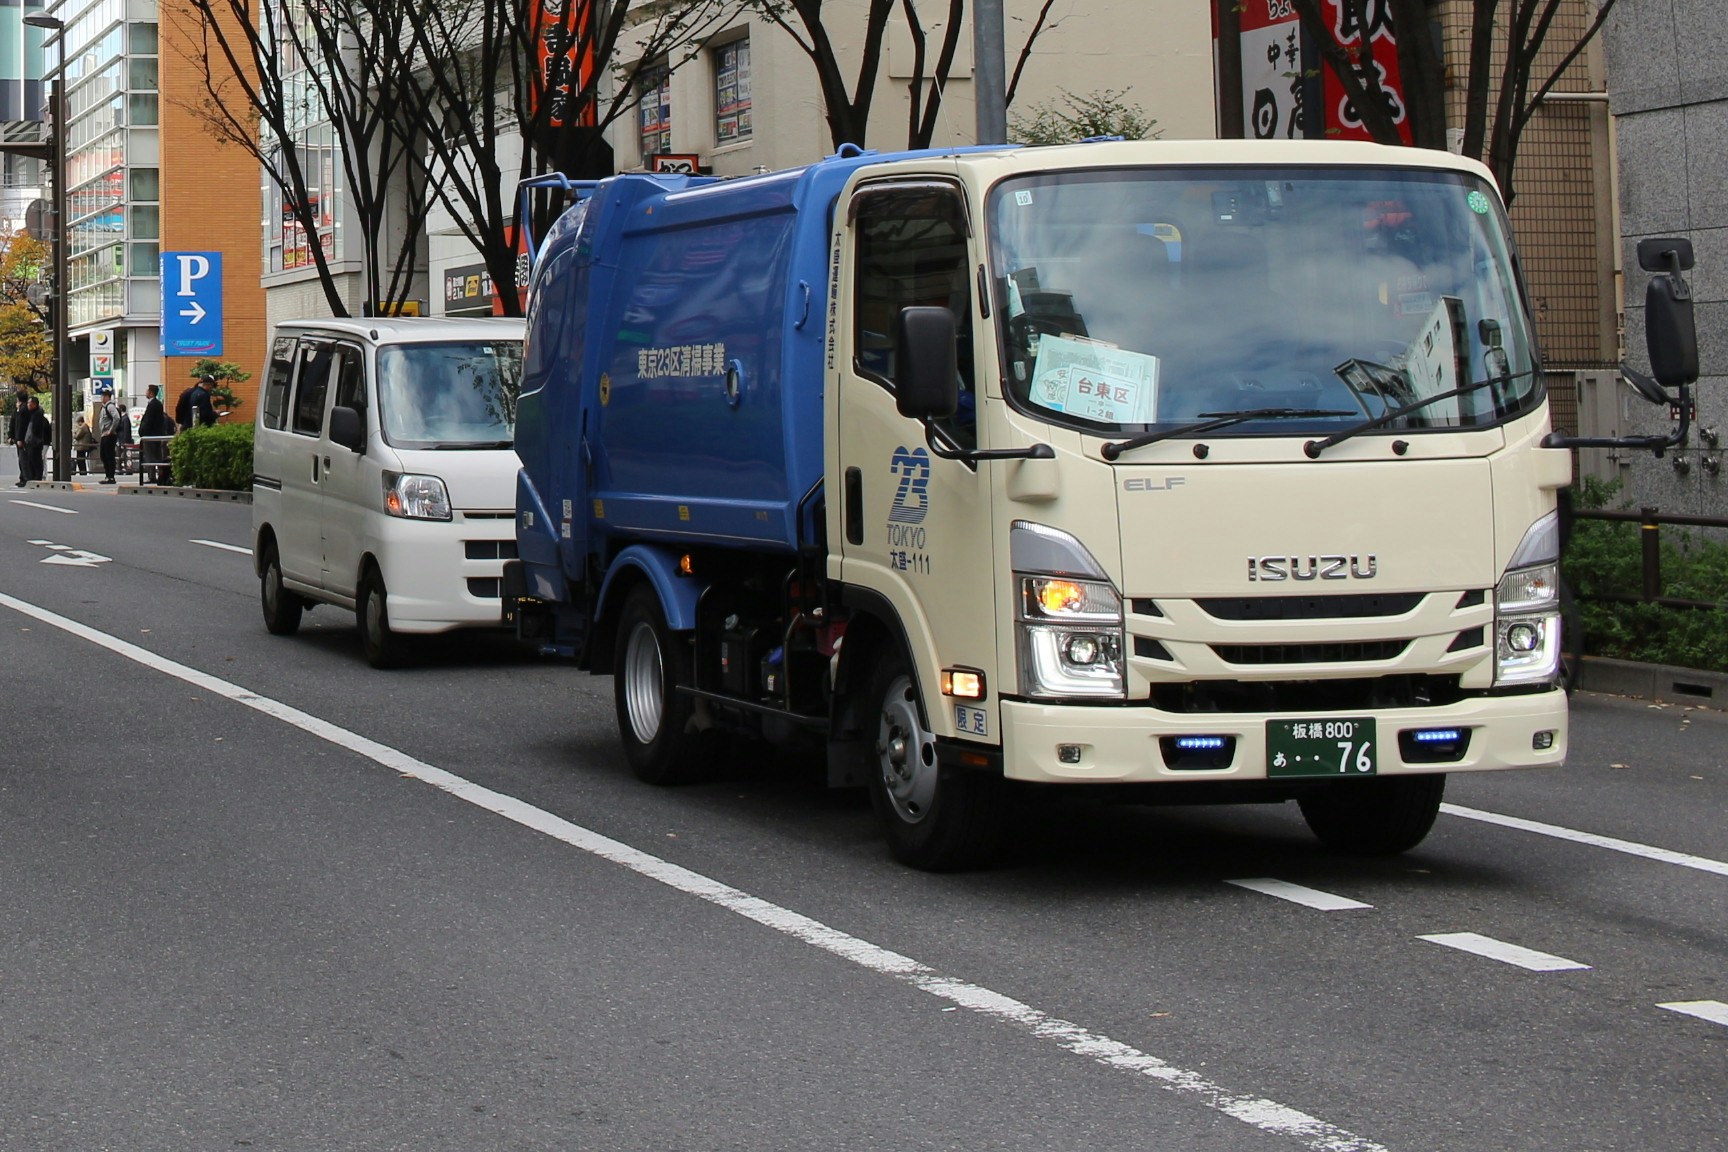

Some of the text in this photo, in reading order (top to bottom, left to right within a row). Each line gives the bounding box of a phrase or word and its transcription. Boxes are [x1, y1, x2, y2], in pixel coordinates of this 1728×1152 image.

[1267, 26, 1300, 71] 中華
[176, 255, 210, 297] P
[637, 342, 726, 379] 東京23区清掃事業
[92, 379, 102, 395] P
[1077, 377, 1131, 404] 台東区
[888, 446, 930, 524] 23
[1124, 476, 1186, 492] ELF
[886, 523, 926, 550] TOKYO
[1247, 553, 1377, 582] ISUZU
[956, 707, 985, 734] 限定
